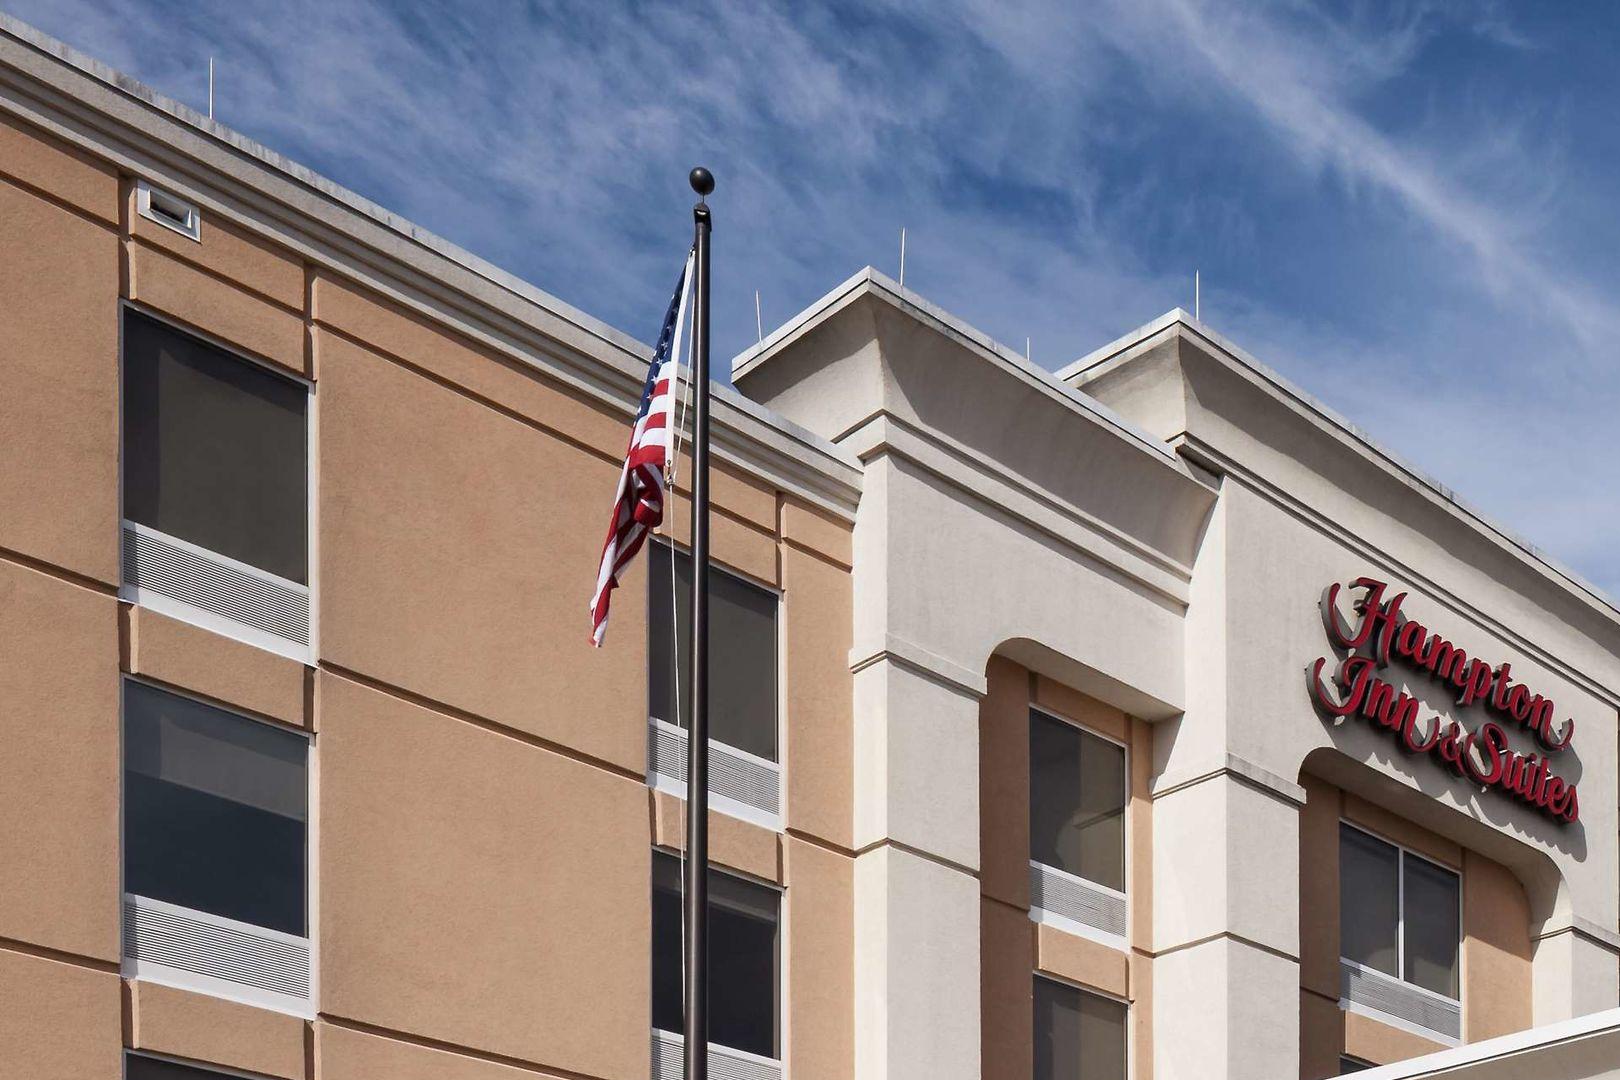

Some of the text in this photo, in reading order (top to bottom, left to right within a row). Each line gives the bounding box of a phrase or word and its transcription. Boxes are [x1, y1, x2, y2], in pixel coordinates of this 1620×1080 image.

[1306, 655, 1579, 823] Inn & Suites
[1320, 576, 1575, 751] Hampton
